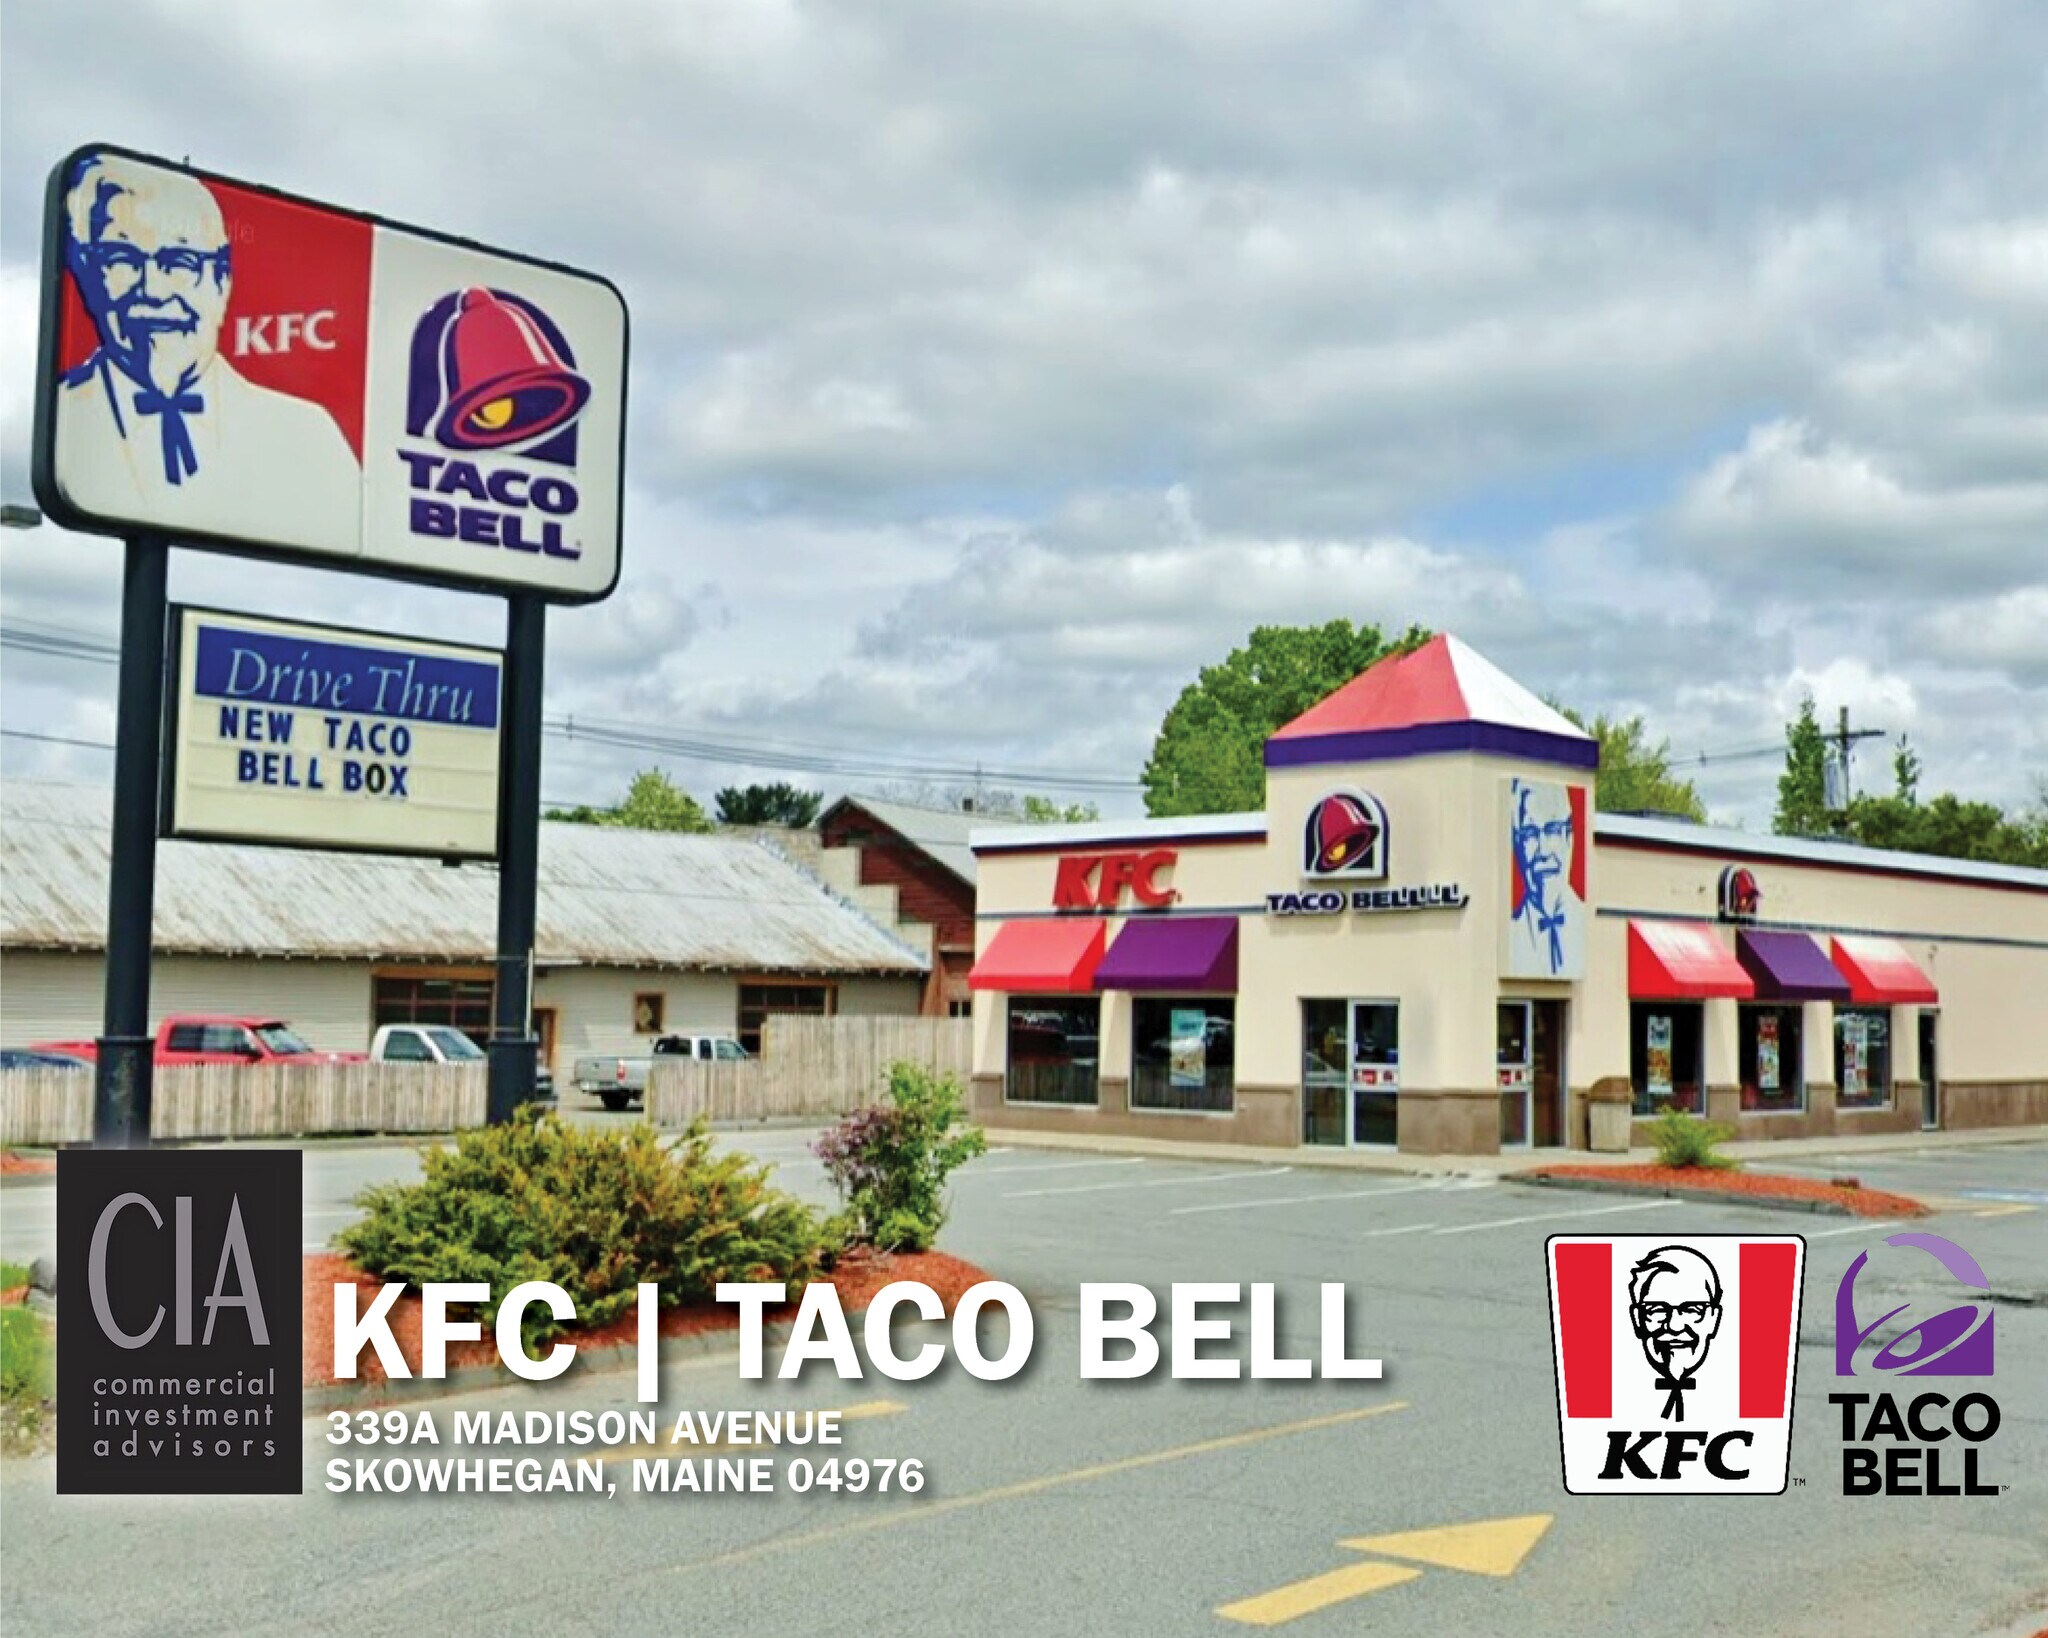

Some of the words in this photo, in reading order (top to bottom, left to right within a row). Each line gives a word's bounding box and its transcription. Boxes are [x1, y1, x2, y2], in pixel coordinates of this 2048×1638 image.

[234, 309, 336, 356] KFC
[397, 450, 580, 516] TACO
[409, 497, 581, 561] BELL
[224, 648, 352, 708] Drive
[368, 658, 473, 723] Thru
[219, 706, 293, 744] NEW
[324, 717, 411, 757] TACO
[238, 750, 323, 790] BELL
[342, 760, 408, 797] BOX
[1052, 850, 1178, 907] KFC
[1266, 891, 1343, 912] TACO
